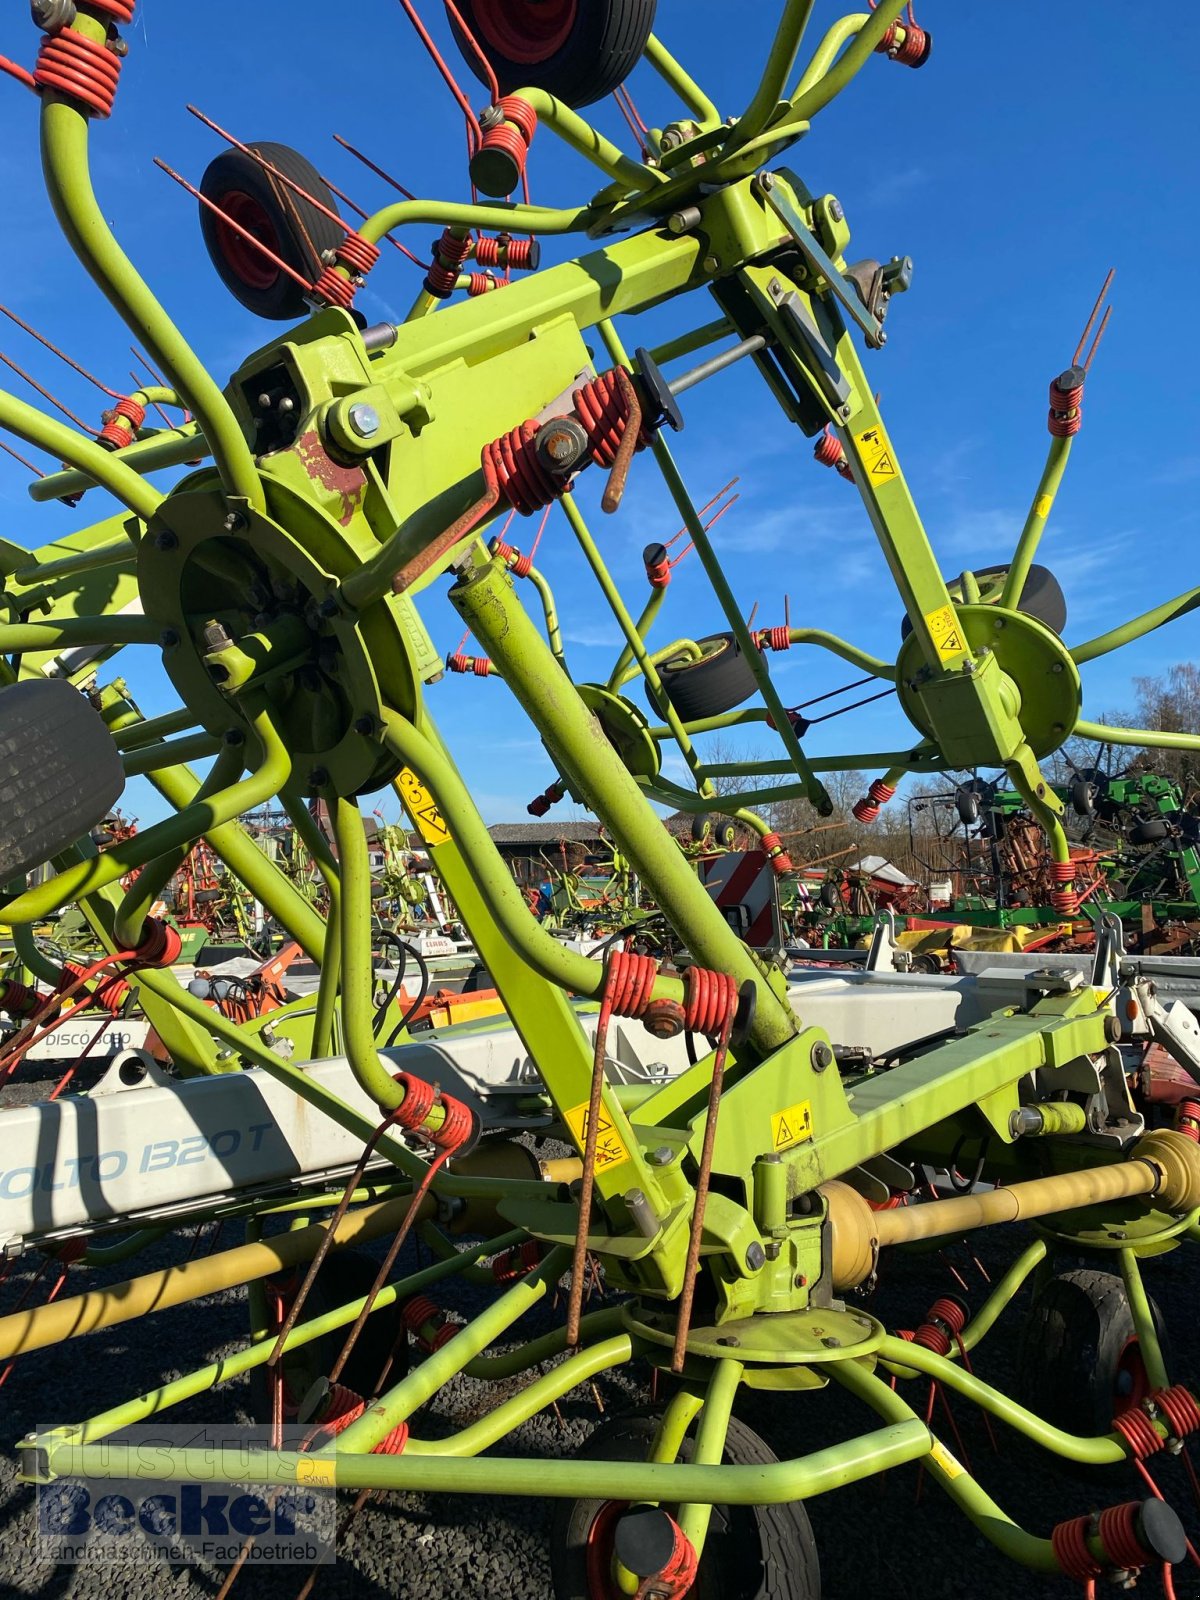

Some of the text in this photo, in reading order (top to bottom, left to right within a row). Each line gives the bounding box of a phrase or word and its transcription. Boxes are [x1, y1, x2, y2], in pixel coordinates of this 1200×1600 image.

[943, 611, 954, 628] STOP
[45, 1033, 90, 1046] DISCO
[0, 1122, 275, 1200] OLTO 1320 T
[303, 1474, 330, 1485] LINKS
